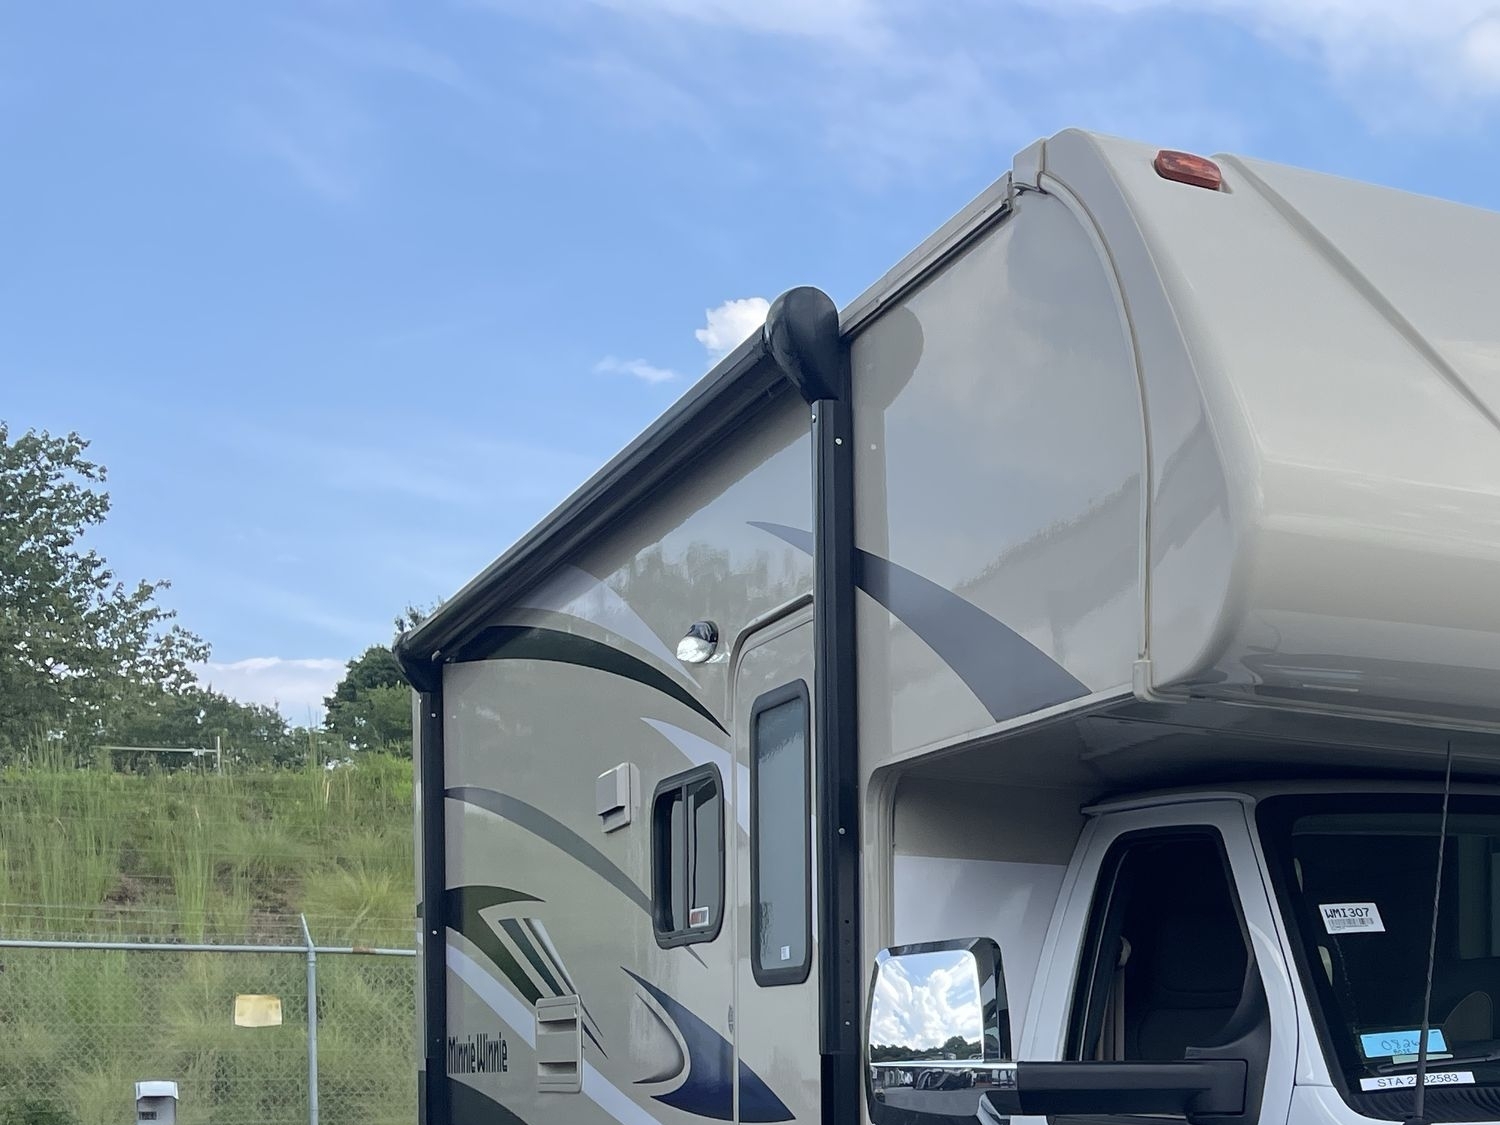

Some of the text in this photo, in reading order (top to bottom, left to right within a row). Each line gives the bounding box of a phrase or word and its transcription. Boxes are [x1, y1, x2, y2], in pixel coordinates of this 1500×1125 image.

[448, 1031, 508, 1075] Minnie Winnie
[1377, 1077, 1404, 1088] STA
